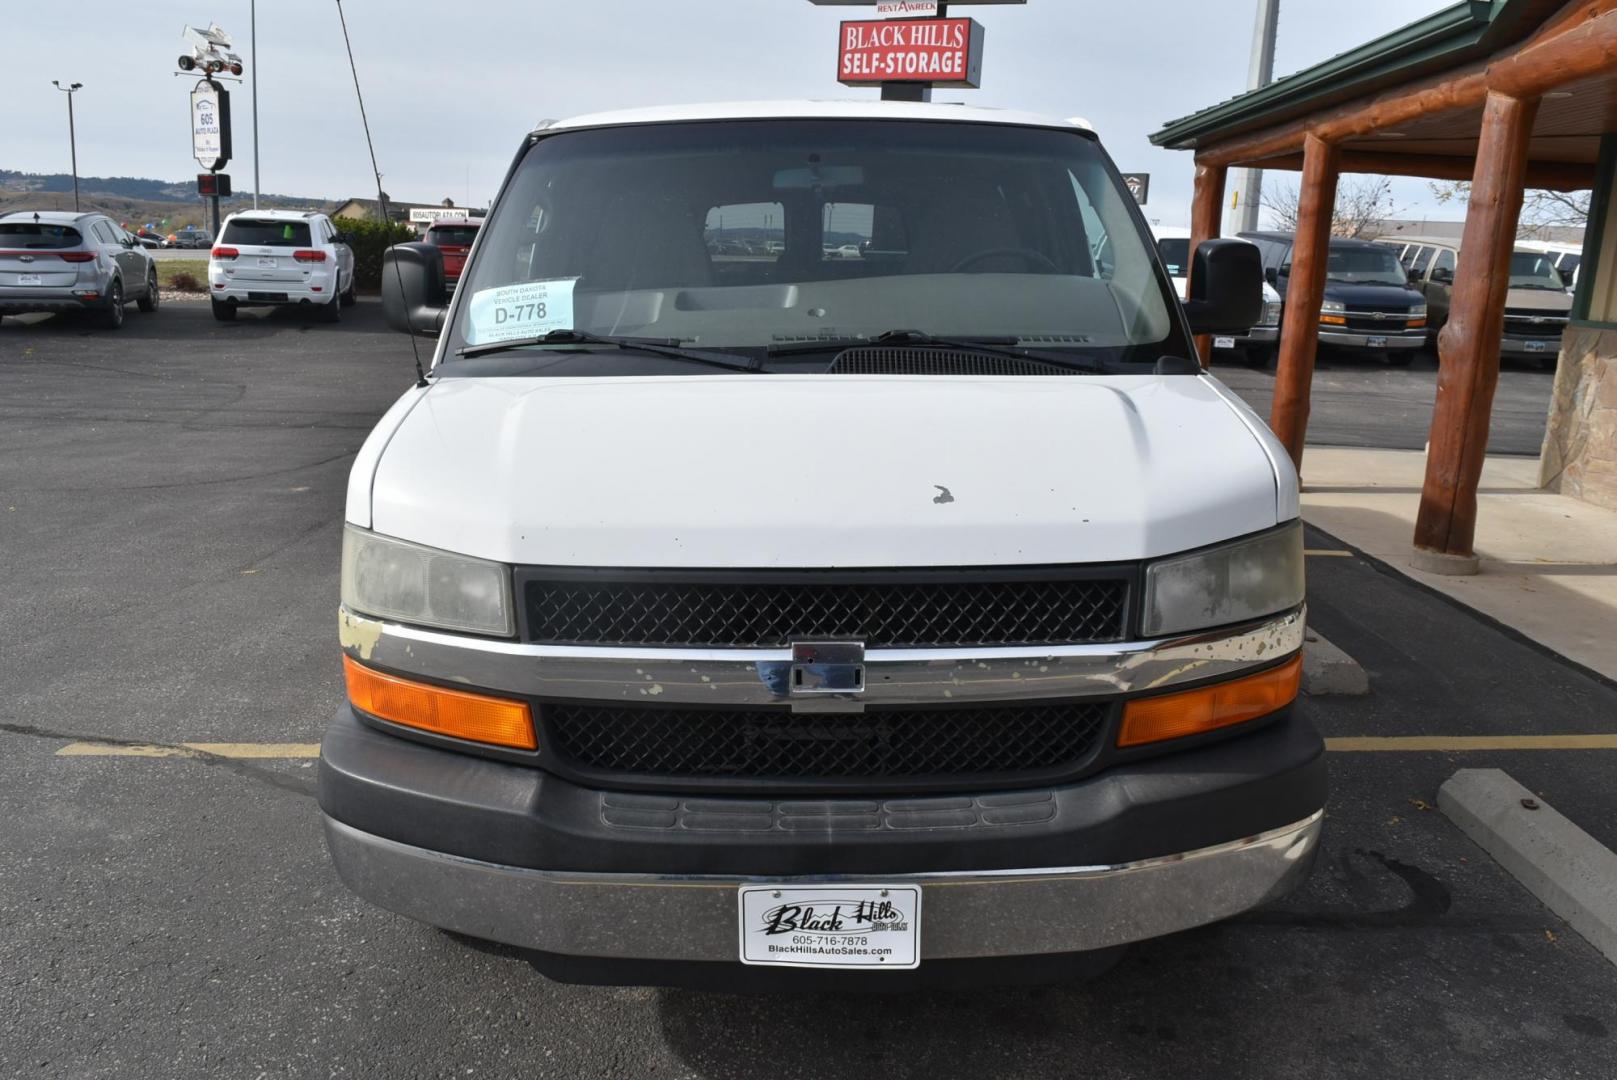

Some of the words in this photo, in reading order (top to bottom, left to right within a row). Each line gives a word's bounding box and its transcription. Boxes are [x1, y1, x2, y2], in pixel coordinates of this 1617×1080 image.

[846, 26, 906, 50] BLACK
[911, 24, 964, 48] HILLS
[843, 51, 963, 74] SELF-STORAGE
[200, 113, 214, 125] 605
[521, 291, 548, 301] DEALER
[495, 302, 547, 324] D-778
[759, 904, 843, 935] Black
[853, 899, 897, 924] Hills
[792, 935, 868, 945] 605-716-7878
[768, 944, 892, 955] BlackHillsAutoSales.com
